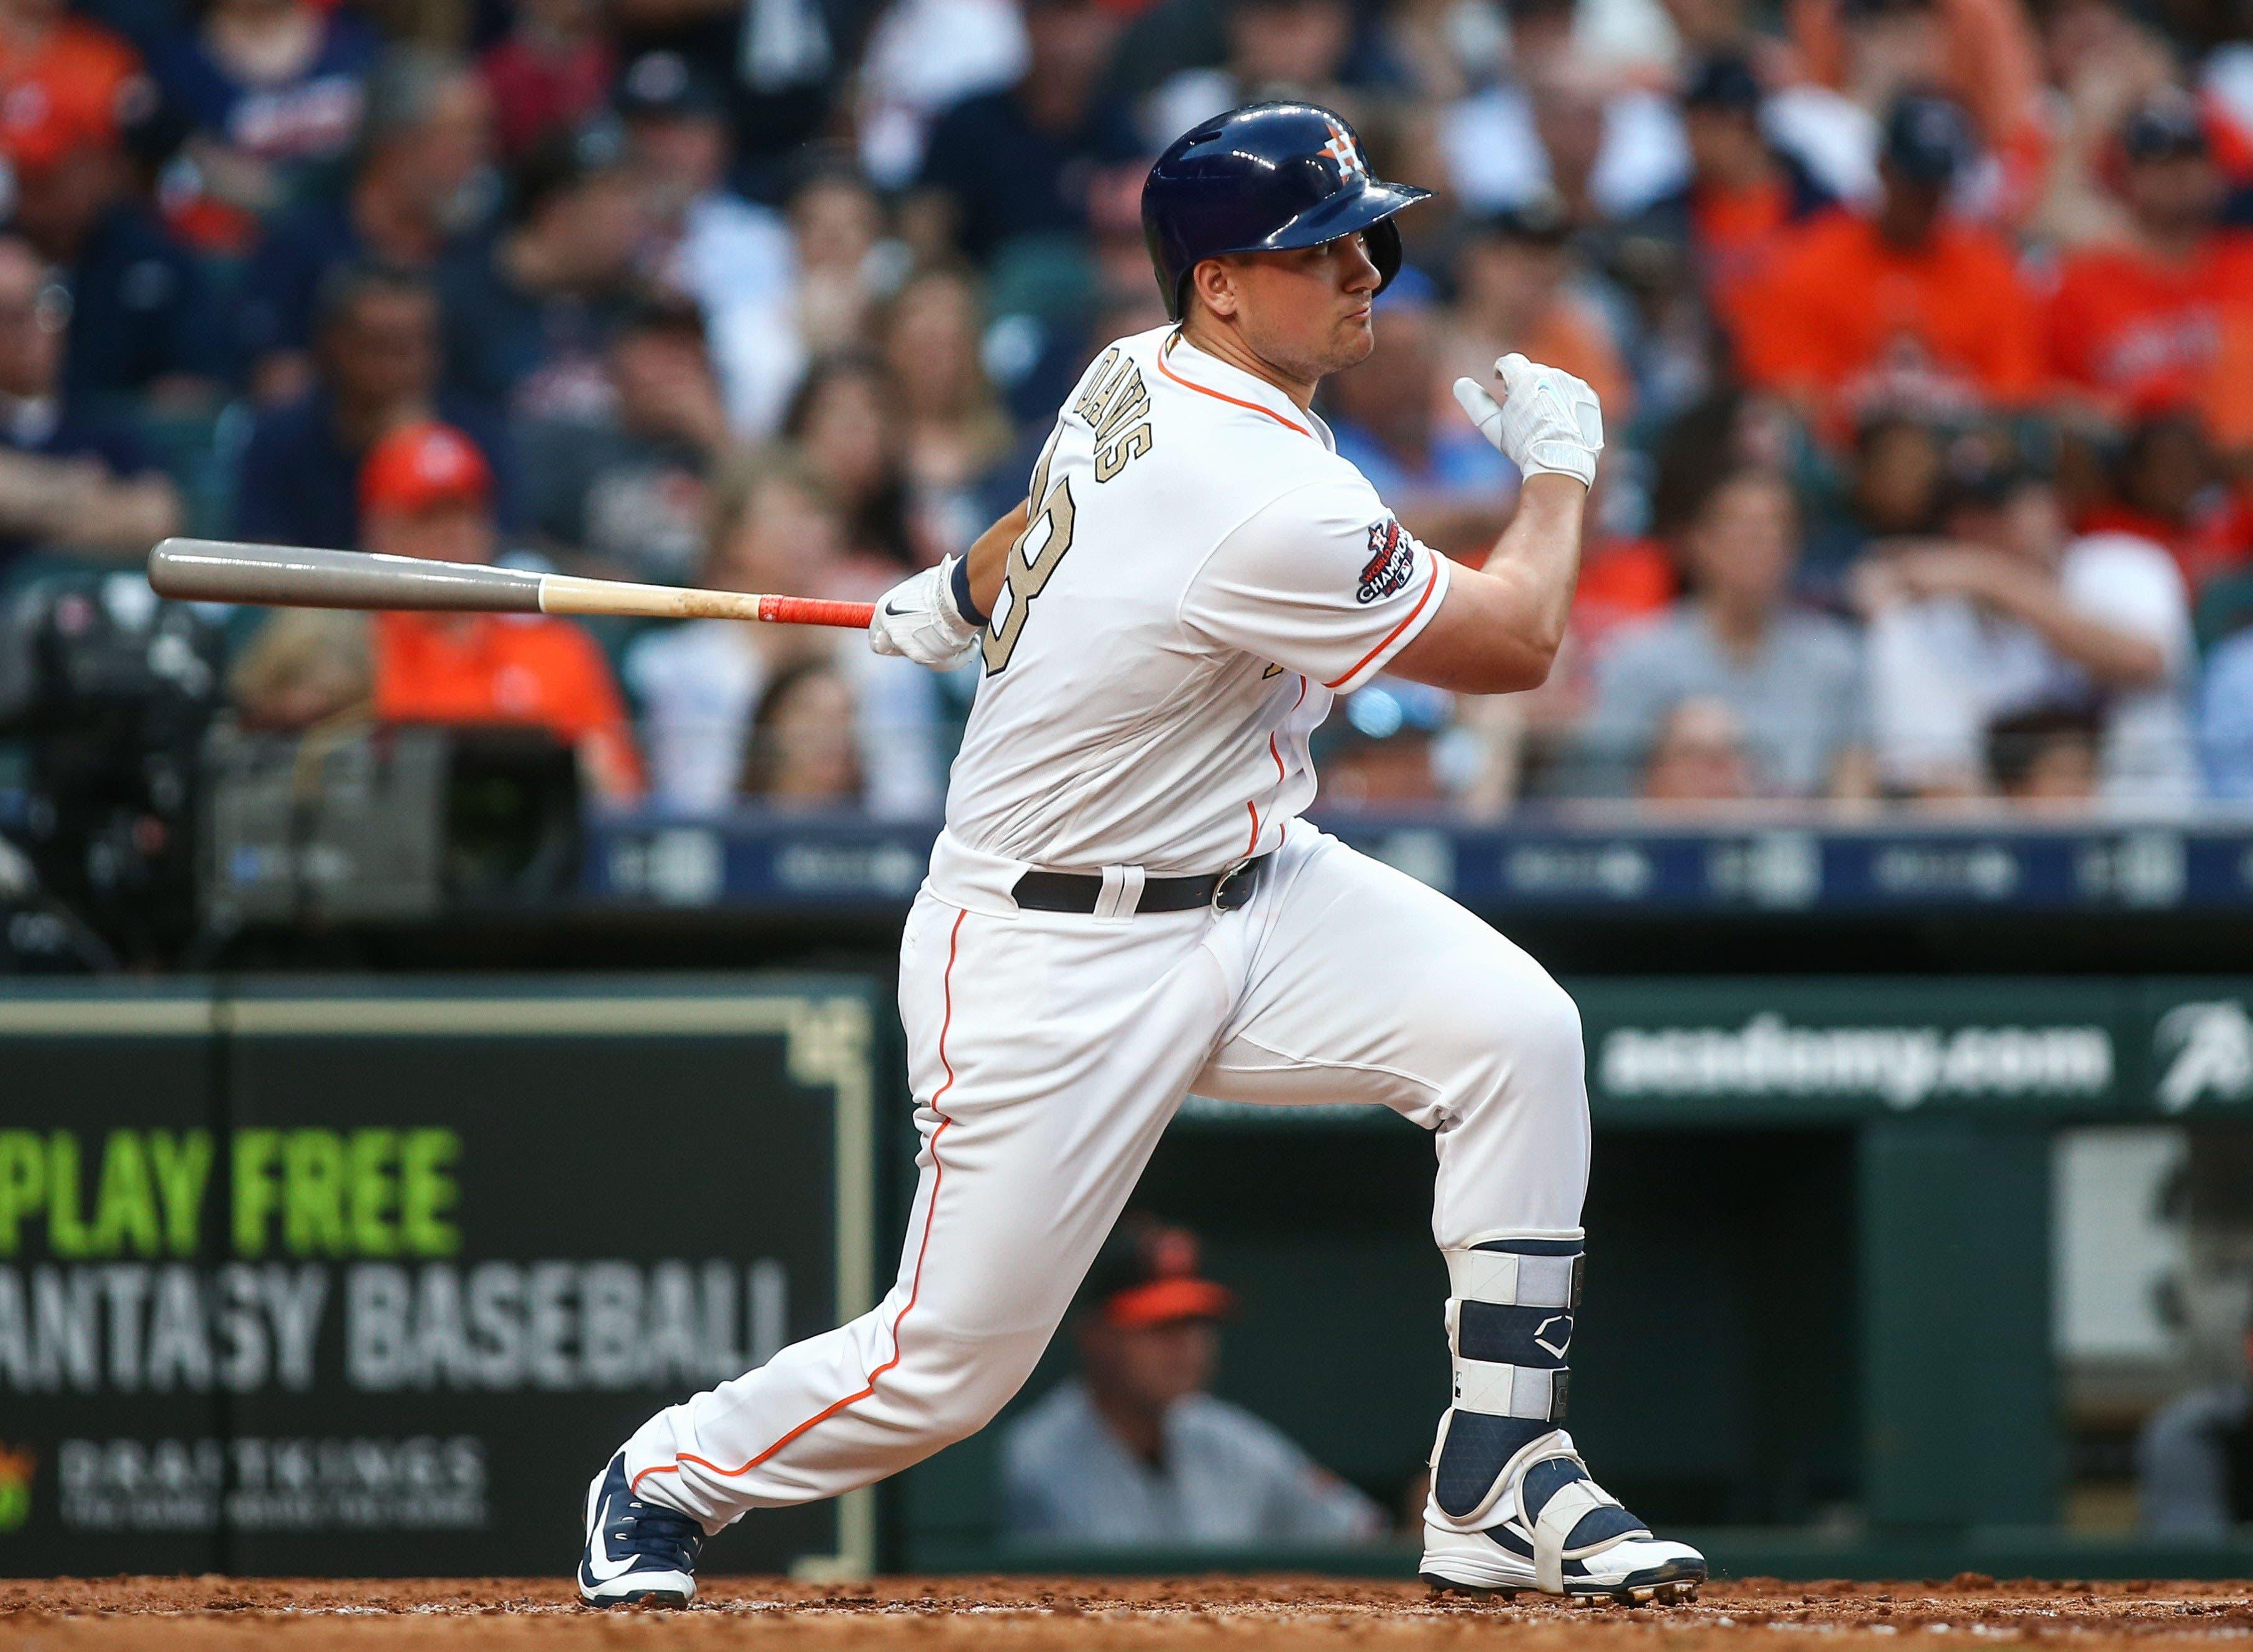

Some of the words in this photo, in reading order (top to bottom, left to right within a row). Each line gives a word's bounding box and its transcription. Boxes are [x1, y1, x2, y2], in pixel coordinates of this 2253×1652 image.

[1072, 347, 1153, 484] DAVIS
[1600, 1009, 2112, 1111] academy.com
[0, 1127, 215, 1258] PLAY
[231, 1126, 461, 1258] FREE
[347, 1259, 788, 1392] BASEBALL
